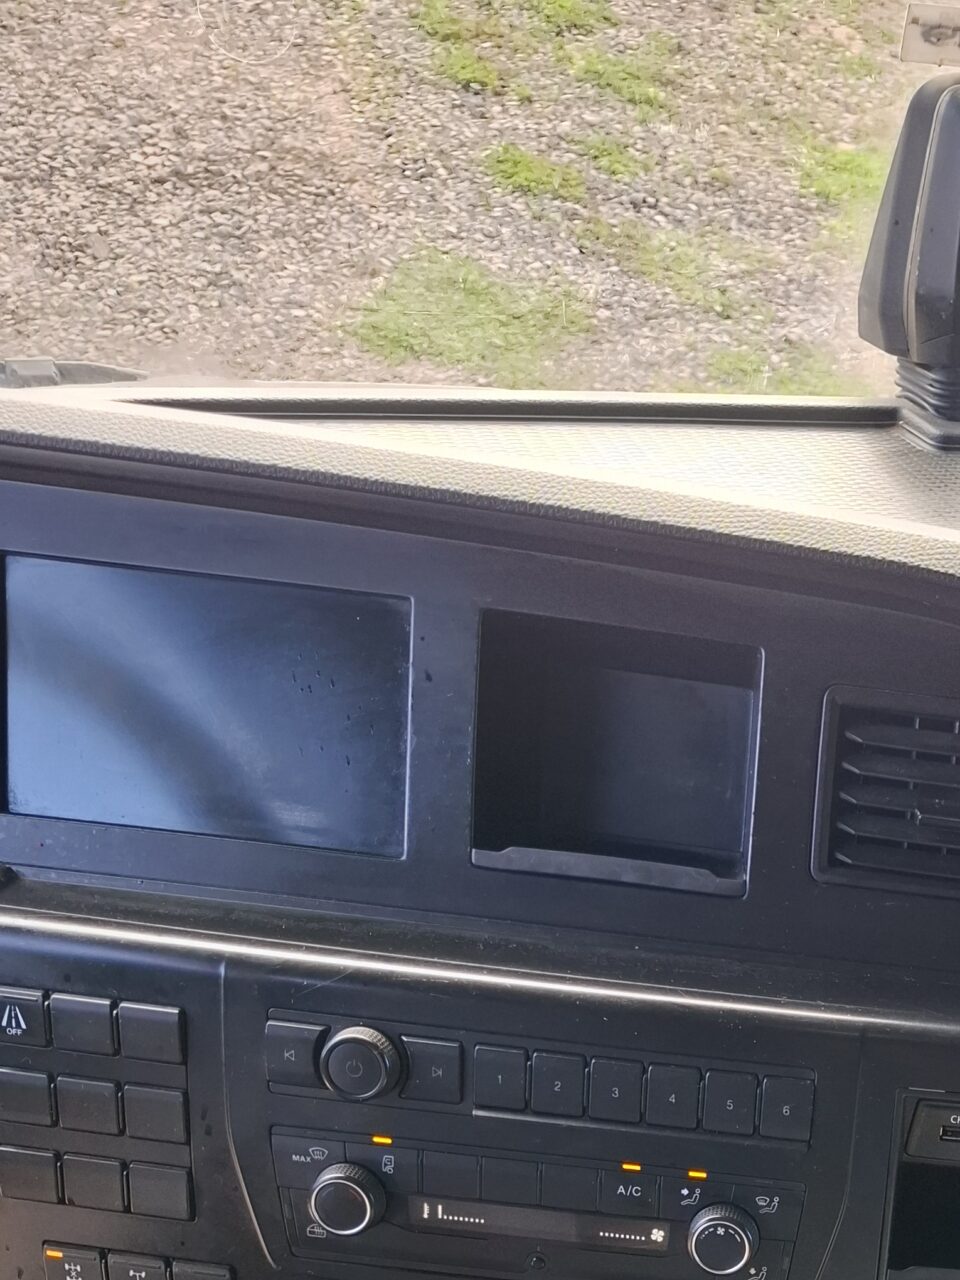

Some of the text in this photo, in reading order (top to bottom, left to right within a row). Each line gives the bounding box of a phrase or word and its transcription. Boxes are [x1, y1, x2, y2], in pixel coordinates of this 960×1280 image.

[6, 1027, 23, 1036] OFF
[497, 1074, 503, 1085] 1
[554, 1081, 561, 1092] 2
[612, 1087, 619, 1098] 3
[668, 1093, 676, 1104] 4
[726, 1100, 733, 1110] 5
[783, 1105, 790, 1116] 6
[292, 1154, 311, 1163] MAX
[617, 1184, 642, 1197] A/C
